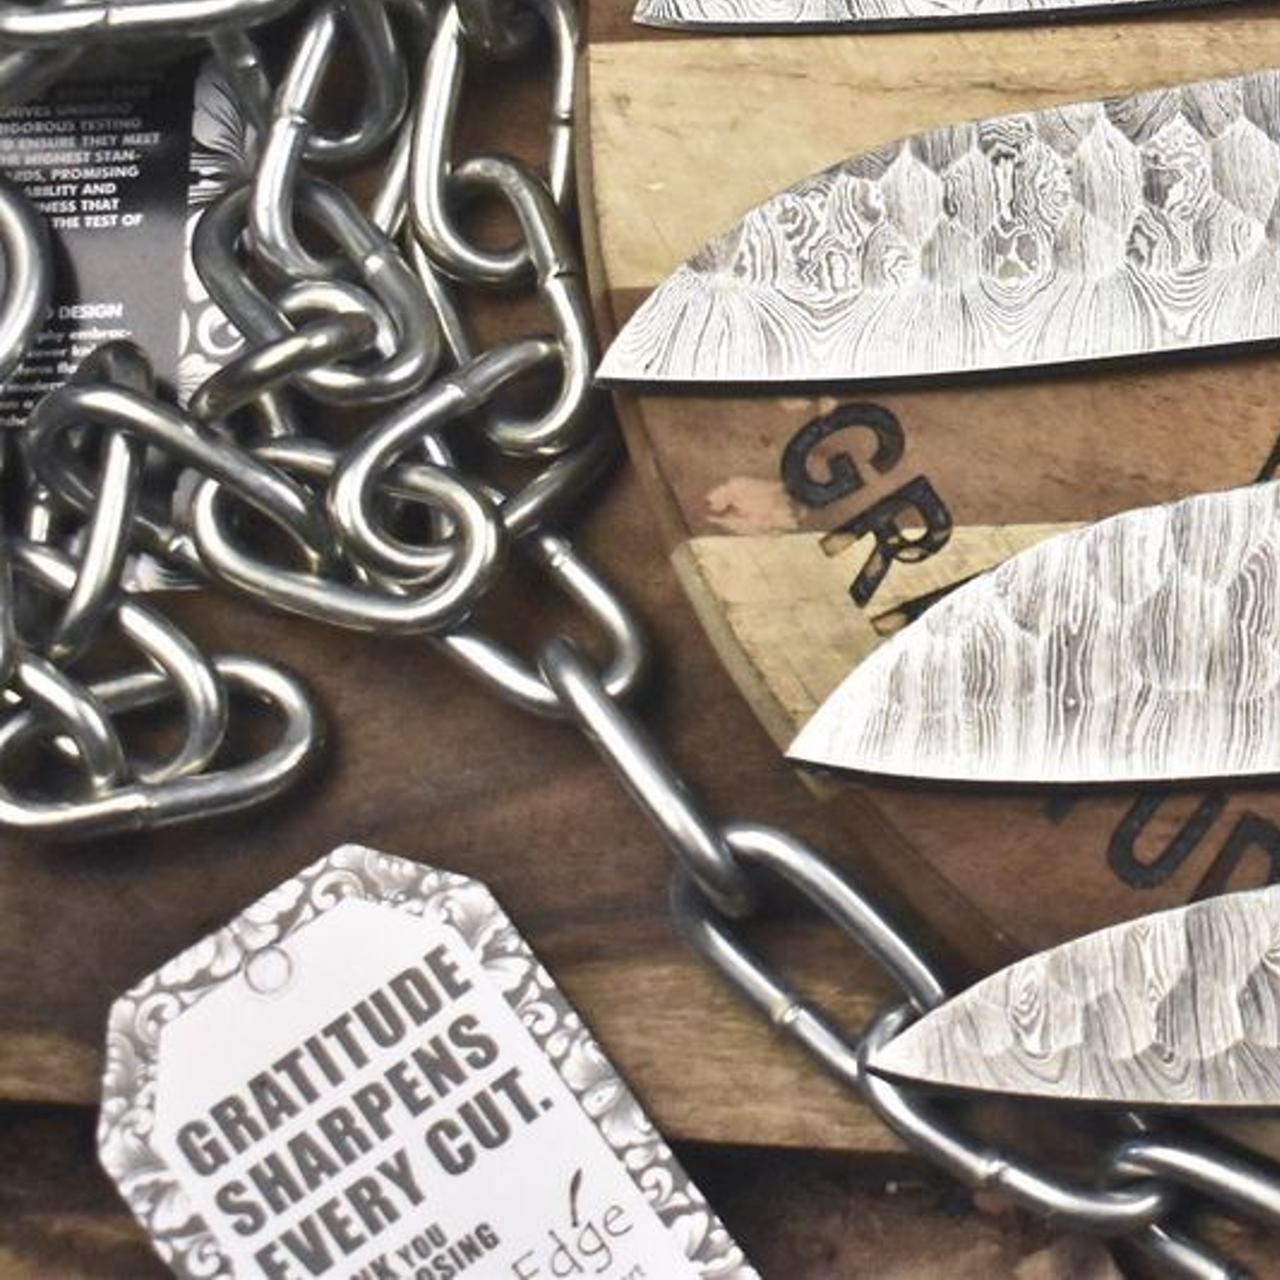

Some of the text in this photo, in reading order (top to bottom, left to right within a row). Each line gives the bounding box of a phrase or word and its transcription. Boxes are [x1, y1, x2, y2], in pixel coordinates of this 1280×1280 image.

[82, 134, 118, 148] THEY
[0, 152, 20, 166] HE
[51, 165, 140, 181] PROMISING
[82, 182, 117, 195] AND
[81, 197, 120, 211] THAT
[52, 213, 144, 229] THE TEST OF
[58, 303, 124, 320] DESIGN
[176, 943, 473, 1177] GRATITUDE
[214, 1013, 500, 1238] SHARPENS
[254, 1067, 555, 1280] EVERY CUT.
[395, 1221, 448, 1269] YOU
